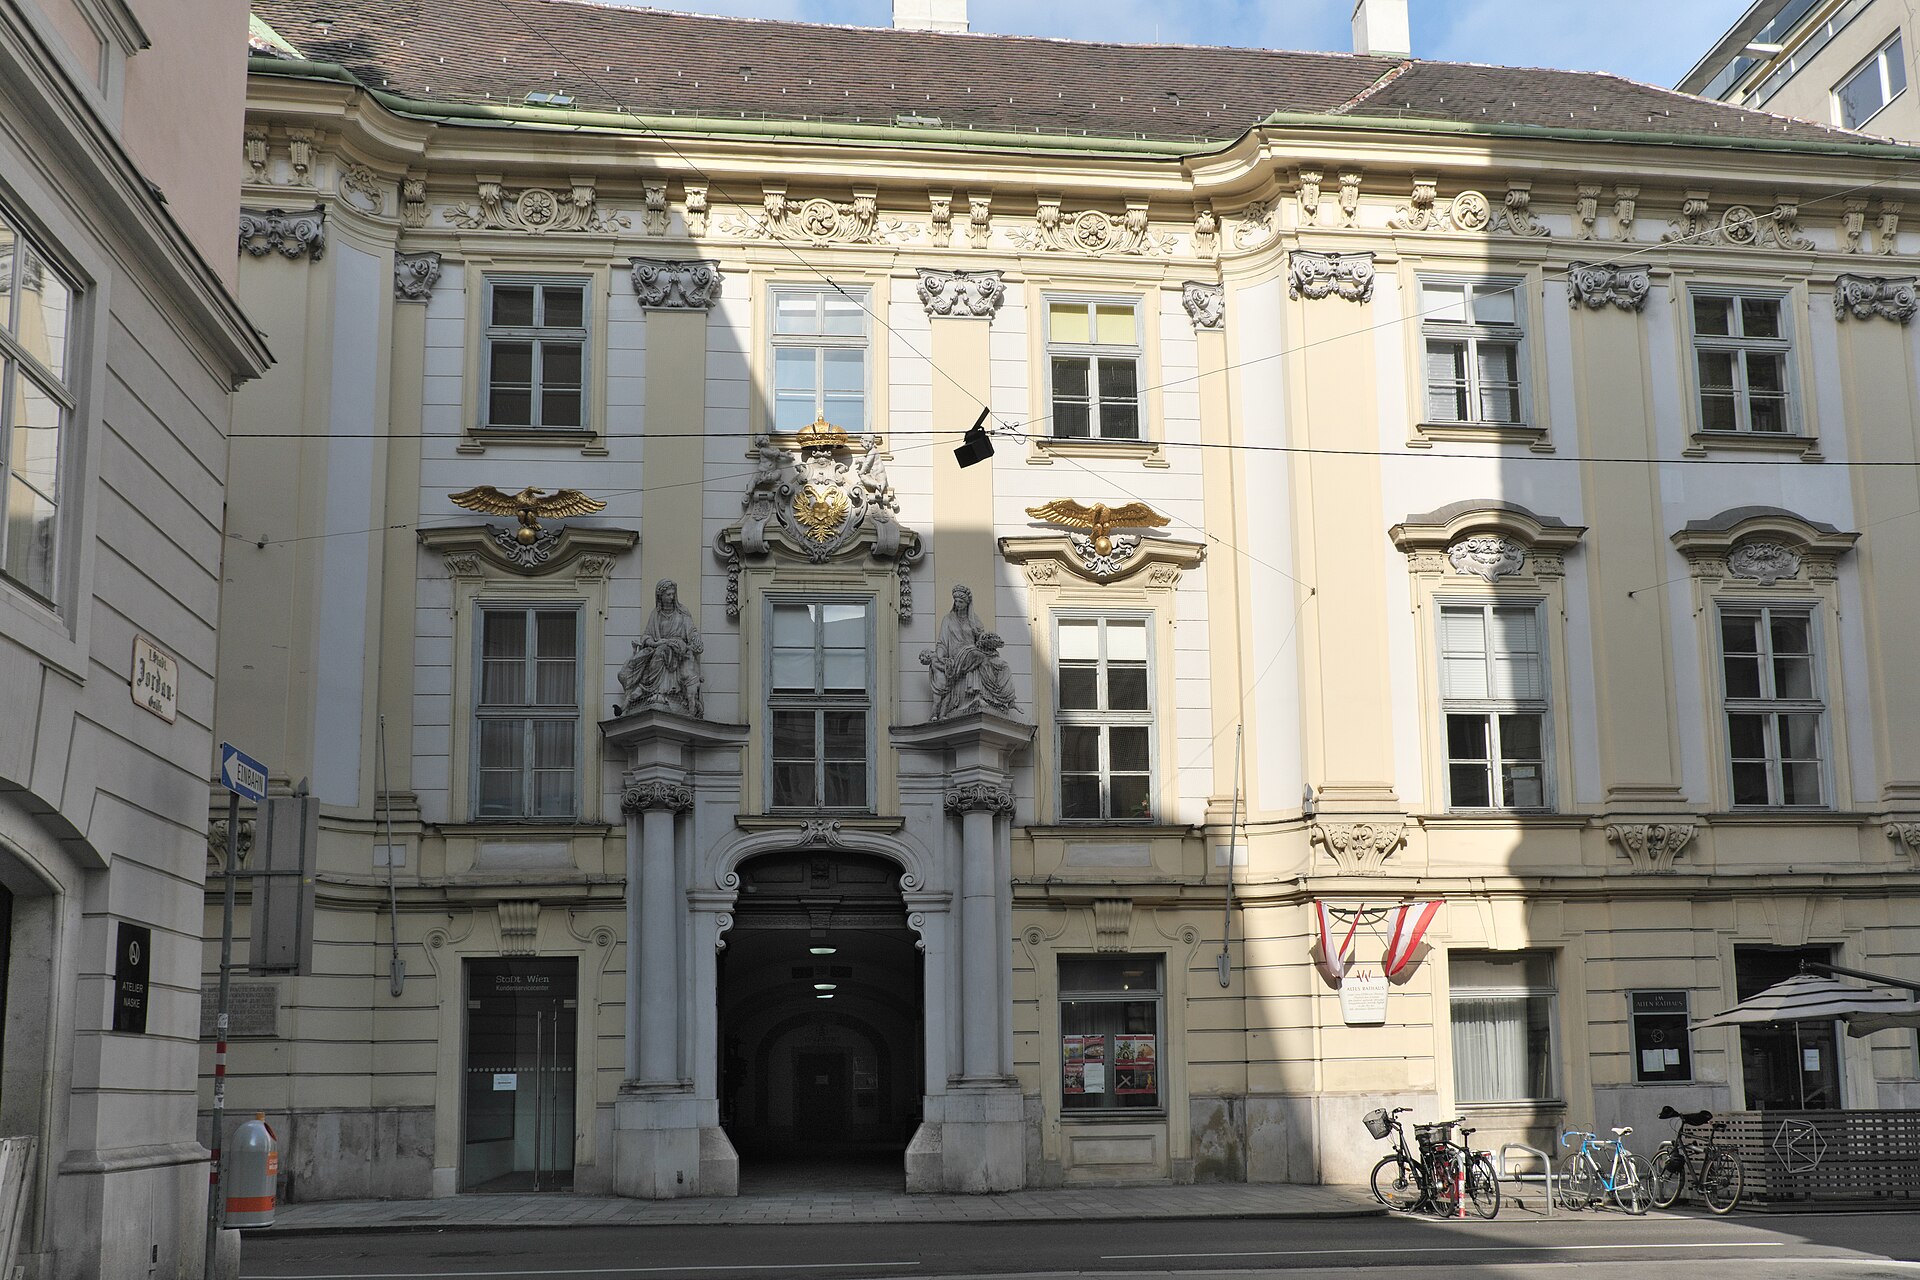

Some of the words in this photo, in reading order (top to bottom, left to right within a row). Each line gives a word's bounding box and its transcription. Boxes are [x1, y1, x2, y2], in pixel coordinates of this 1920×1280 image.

[237, 763, 263, 793] EINBAHN
[527, 974, 549, 983] Wien
[122, 981, 143, 994] ATELIER
[123, 997, 141, 1009] NASKE
